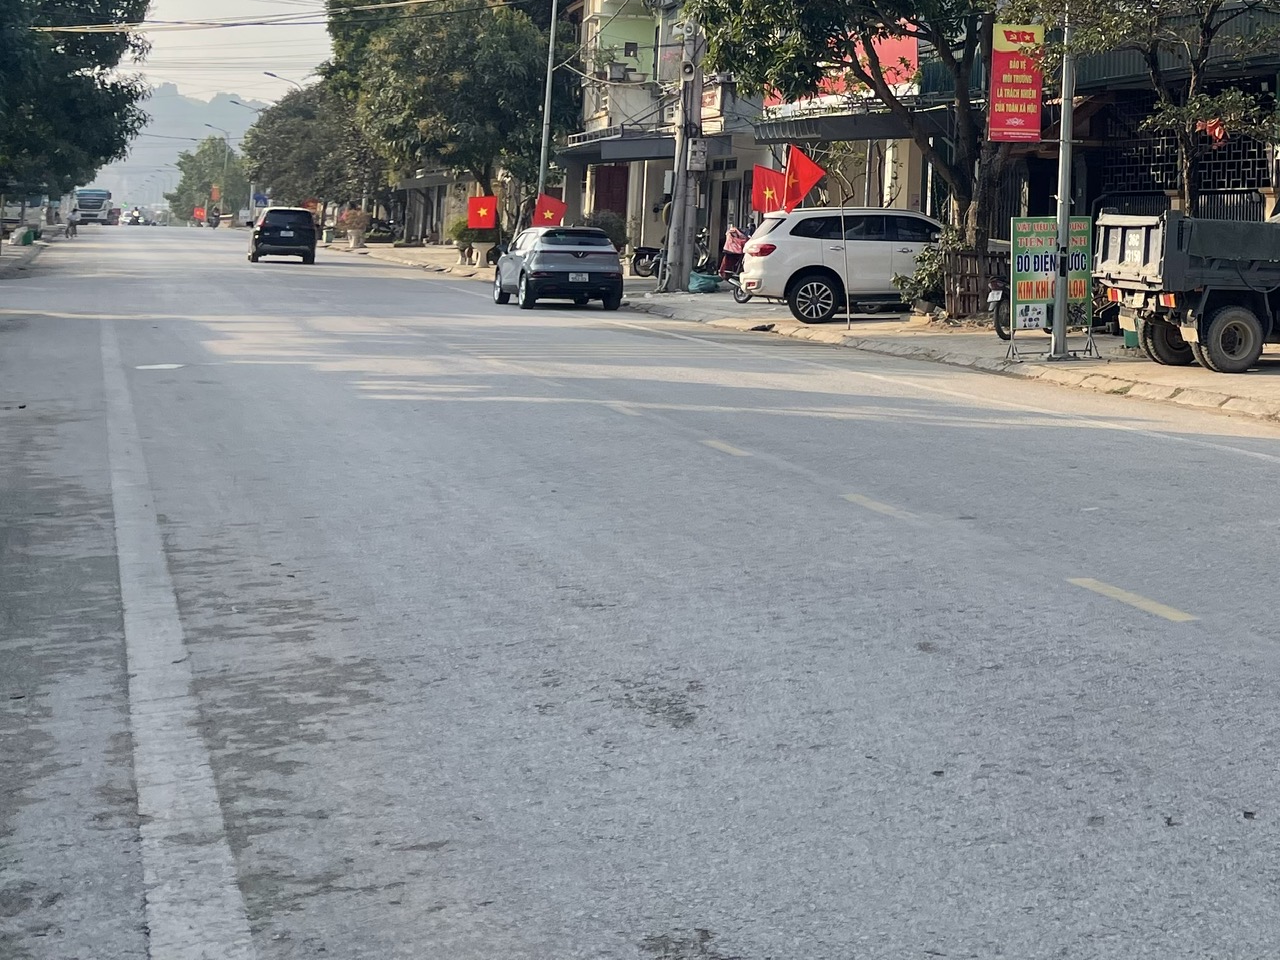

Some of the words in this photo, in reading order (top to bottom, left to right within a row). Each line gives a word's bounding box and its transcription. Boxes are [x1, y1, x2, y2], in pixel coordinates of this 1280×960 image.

[1009, 57, 1019, 69] BẢO
[1020, 58, 1026, 71] VỆ
[1017, 249, 1030, 272] ĐỒ
[1033, 250, 1056, 276] ĐIỆN
[1067, 249, 1087, 271] ƯỚC
[1017, 281, 1034, 300] KIM
[1035, 277, 1049, 299] KHÍ
[1069, 279, 1086, 302] LOẠI
